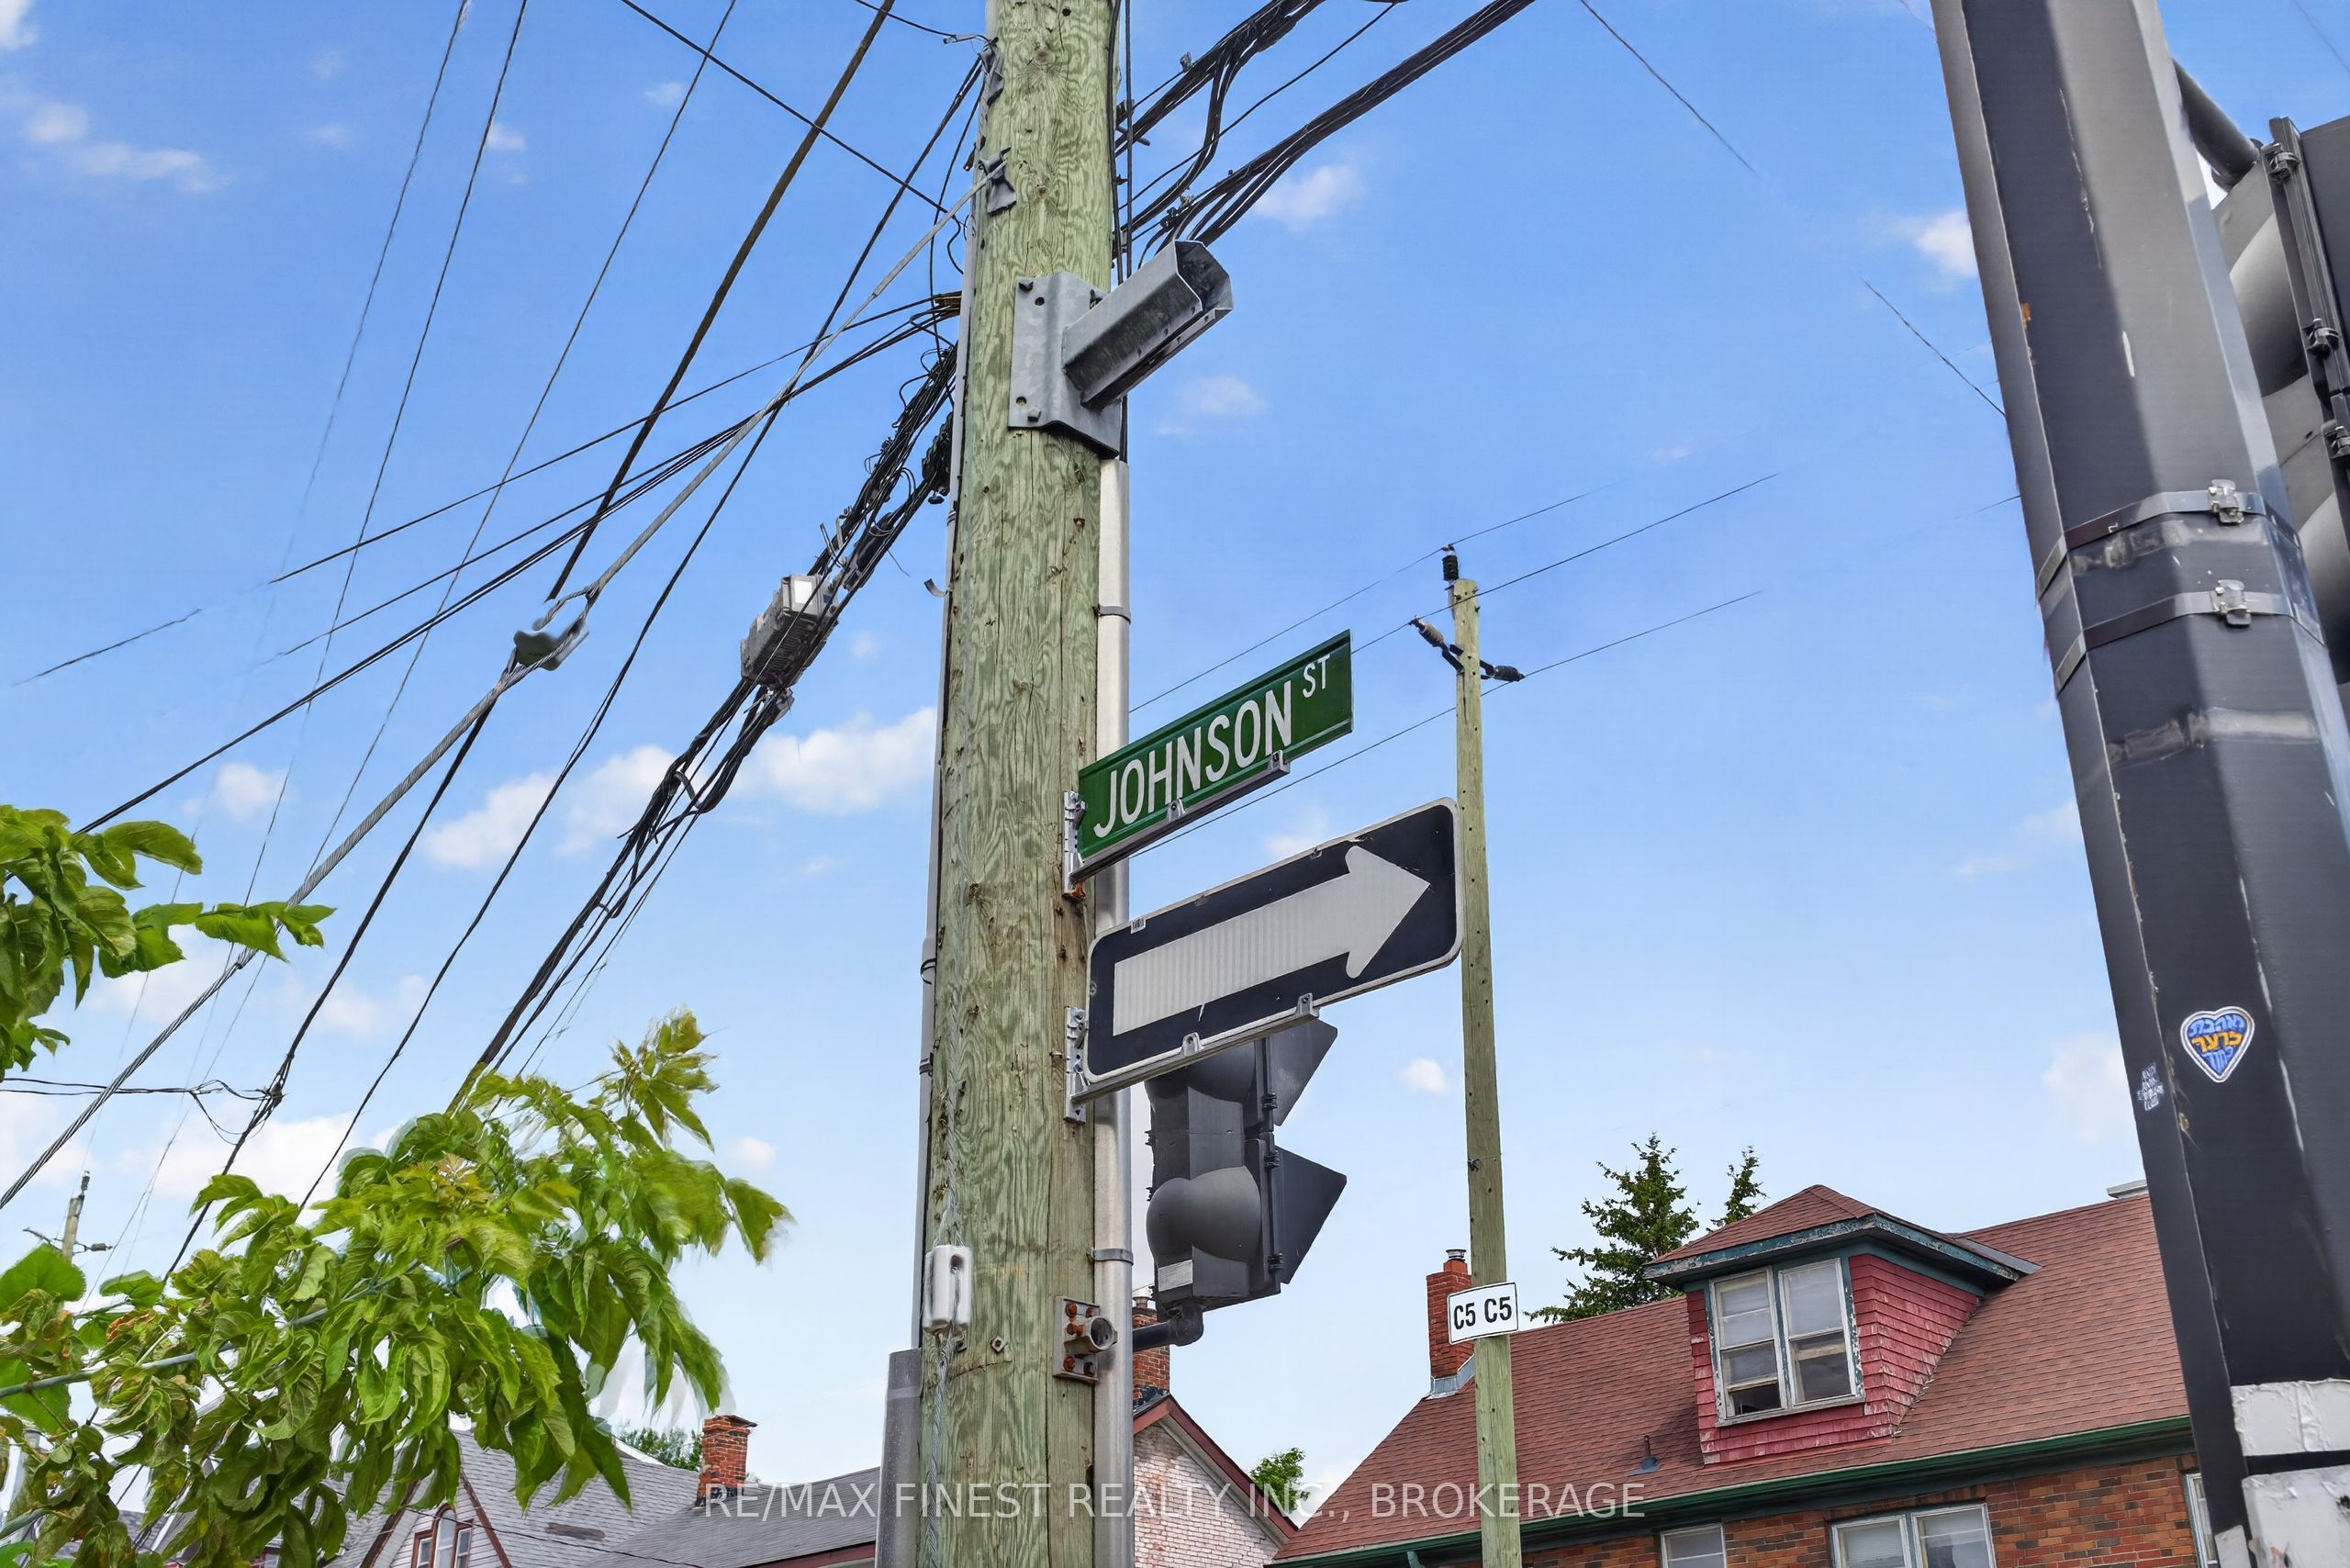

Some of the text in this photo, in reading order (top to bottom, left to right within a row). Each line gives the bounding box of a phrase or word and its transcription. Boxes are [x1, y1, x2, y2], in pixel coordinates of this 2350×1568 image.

[1093, 654, 1330, 838] JOHNSON ST
[1453, 1295, 1512, 1330] C5 C5
